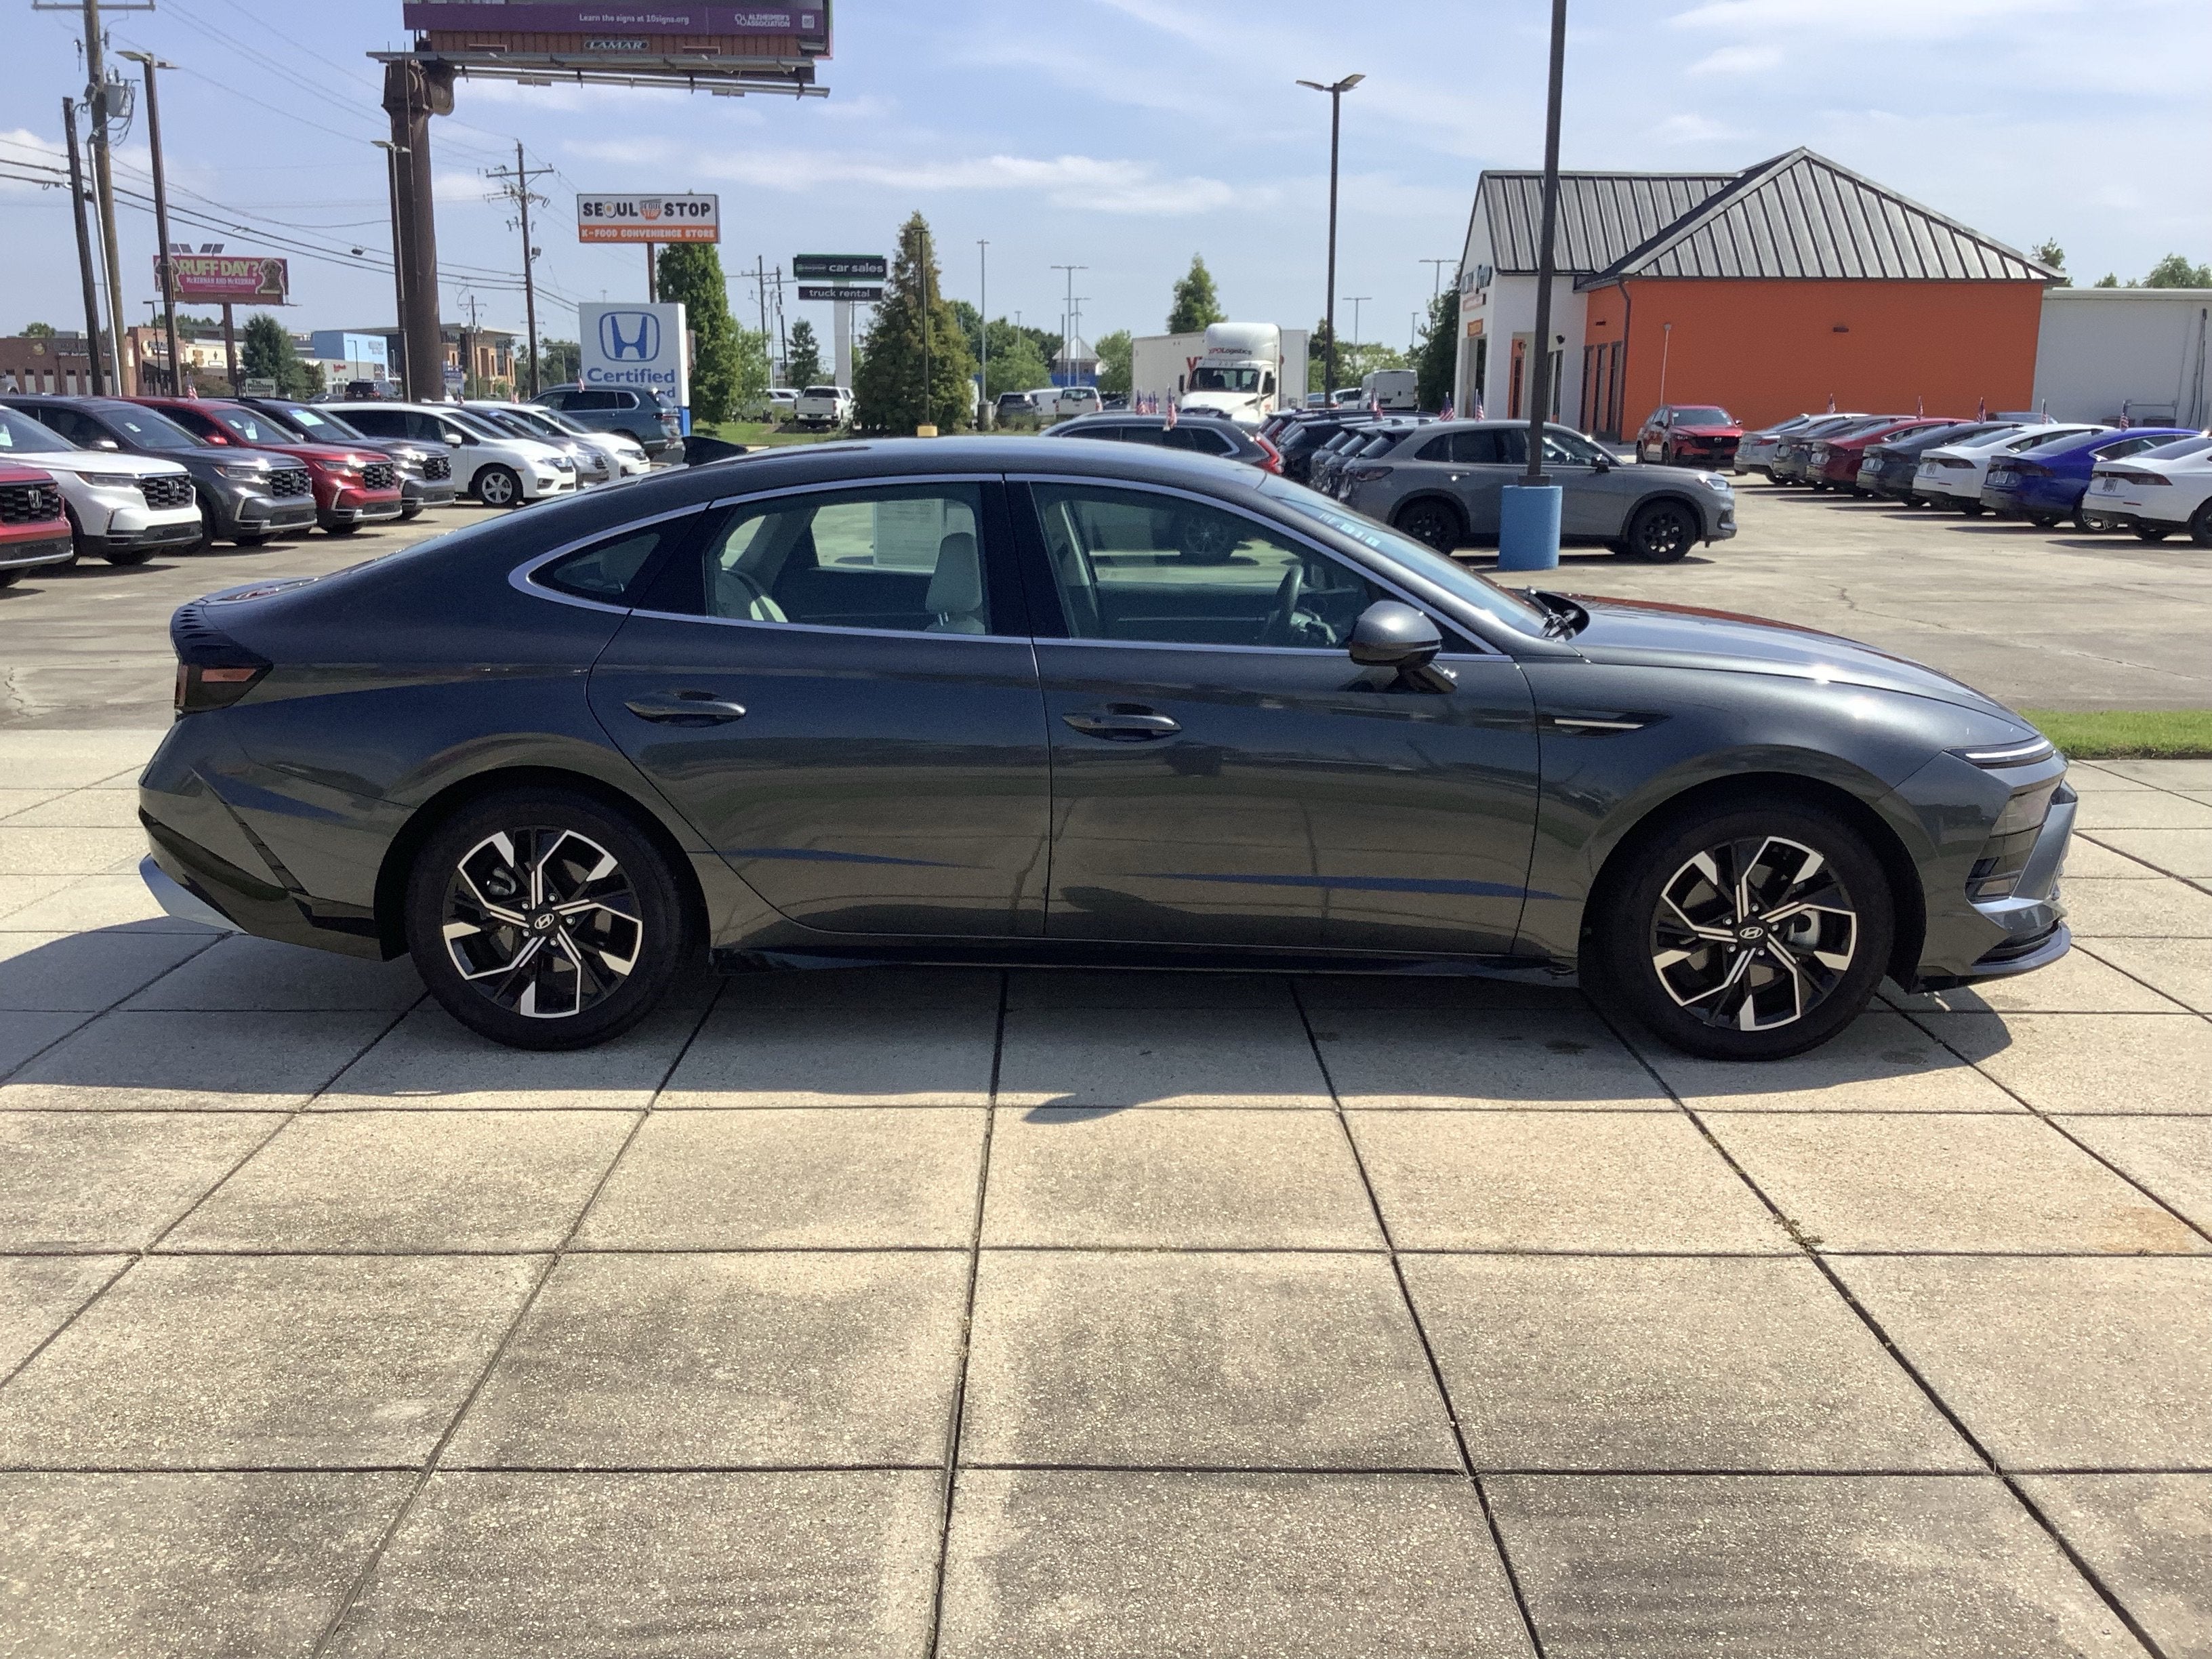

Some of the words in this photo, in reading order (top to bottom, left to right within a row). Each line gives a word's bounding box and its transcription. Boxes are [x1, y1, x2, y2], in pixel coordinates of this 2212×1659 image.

[579, 14, 600, 22] Learn
[602, 14, 615, 22] the
[616, 14, 635, 24] signs
[647, 14, 689, 25] 10signs.org
[589, 41, 642, 49] LAMAR
[583, 202, 638, 218] SEOUL
[664, 202, 711, 217] STOP
[581, 229, 618, 238] K-FOOD
[621, 229, 682, 238] CONVENIENCE
[685, 229, 714, 238] STORE
[179, 260, 219, 276] RUFF
[220, 260, 259, 276] DAY?
[851, 263, 884, 272] sales
[808, 288, 836, 297] truck
[839, 289, 870, 298] rental
[587, 367, 676, 383] Certified
